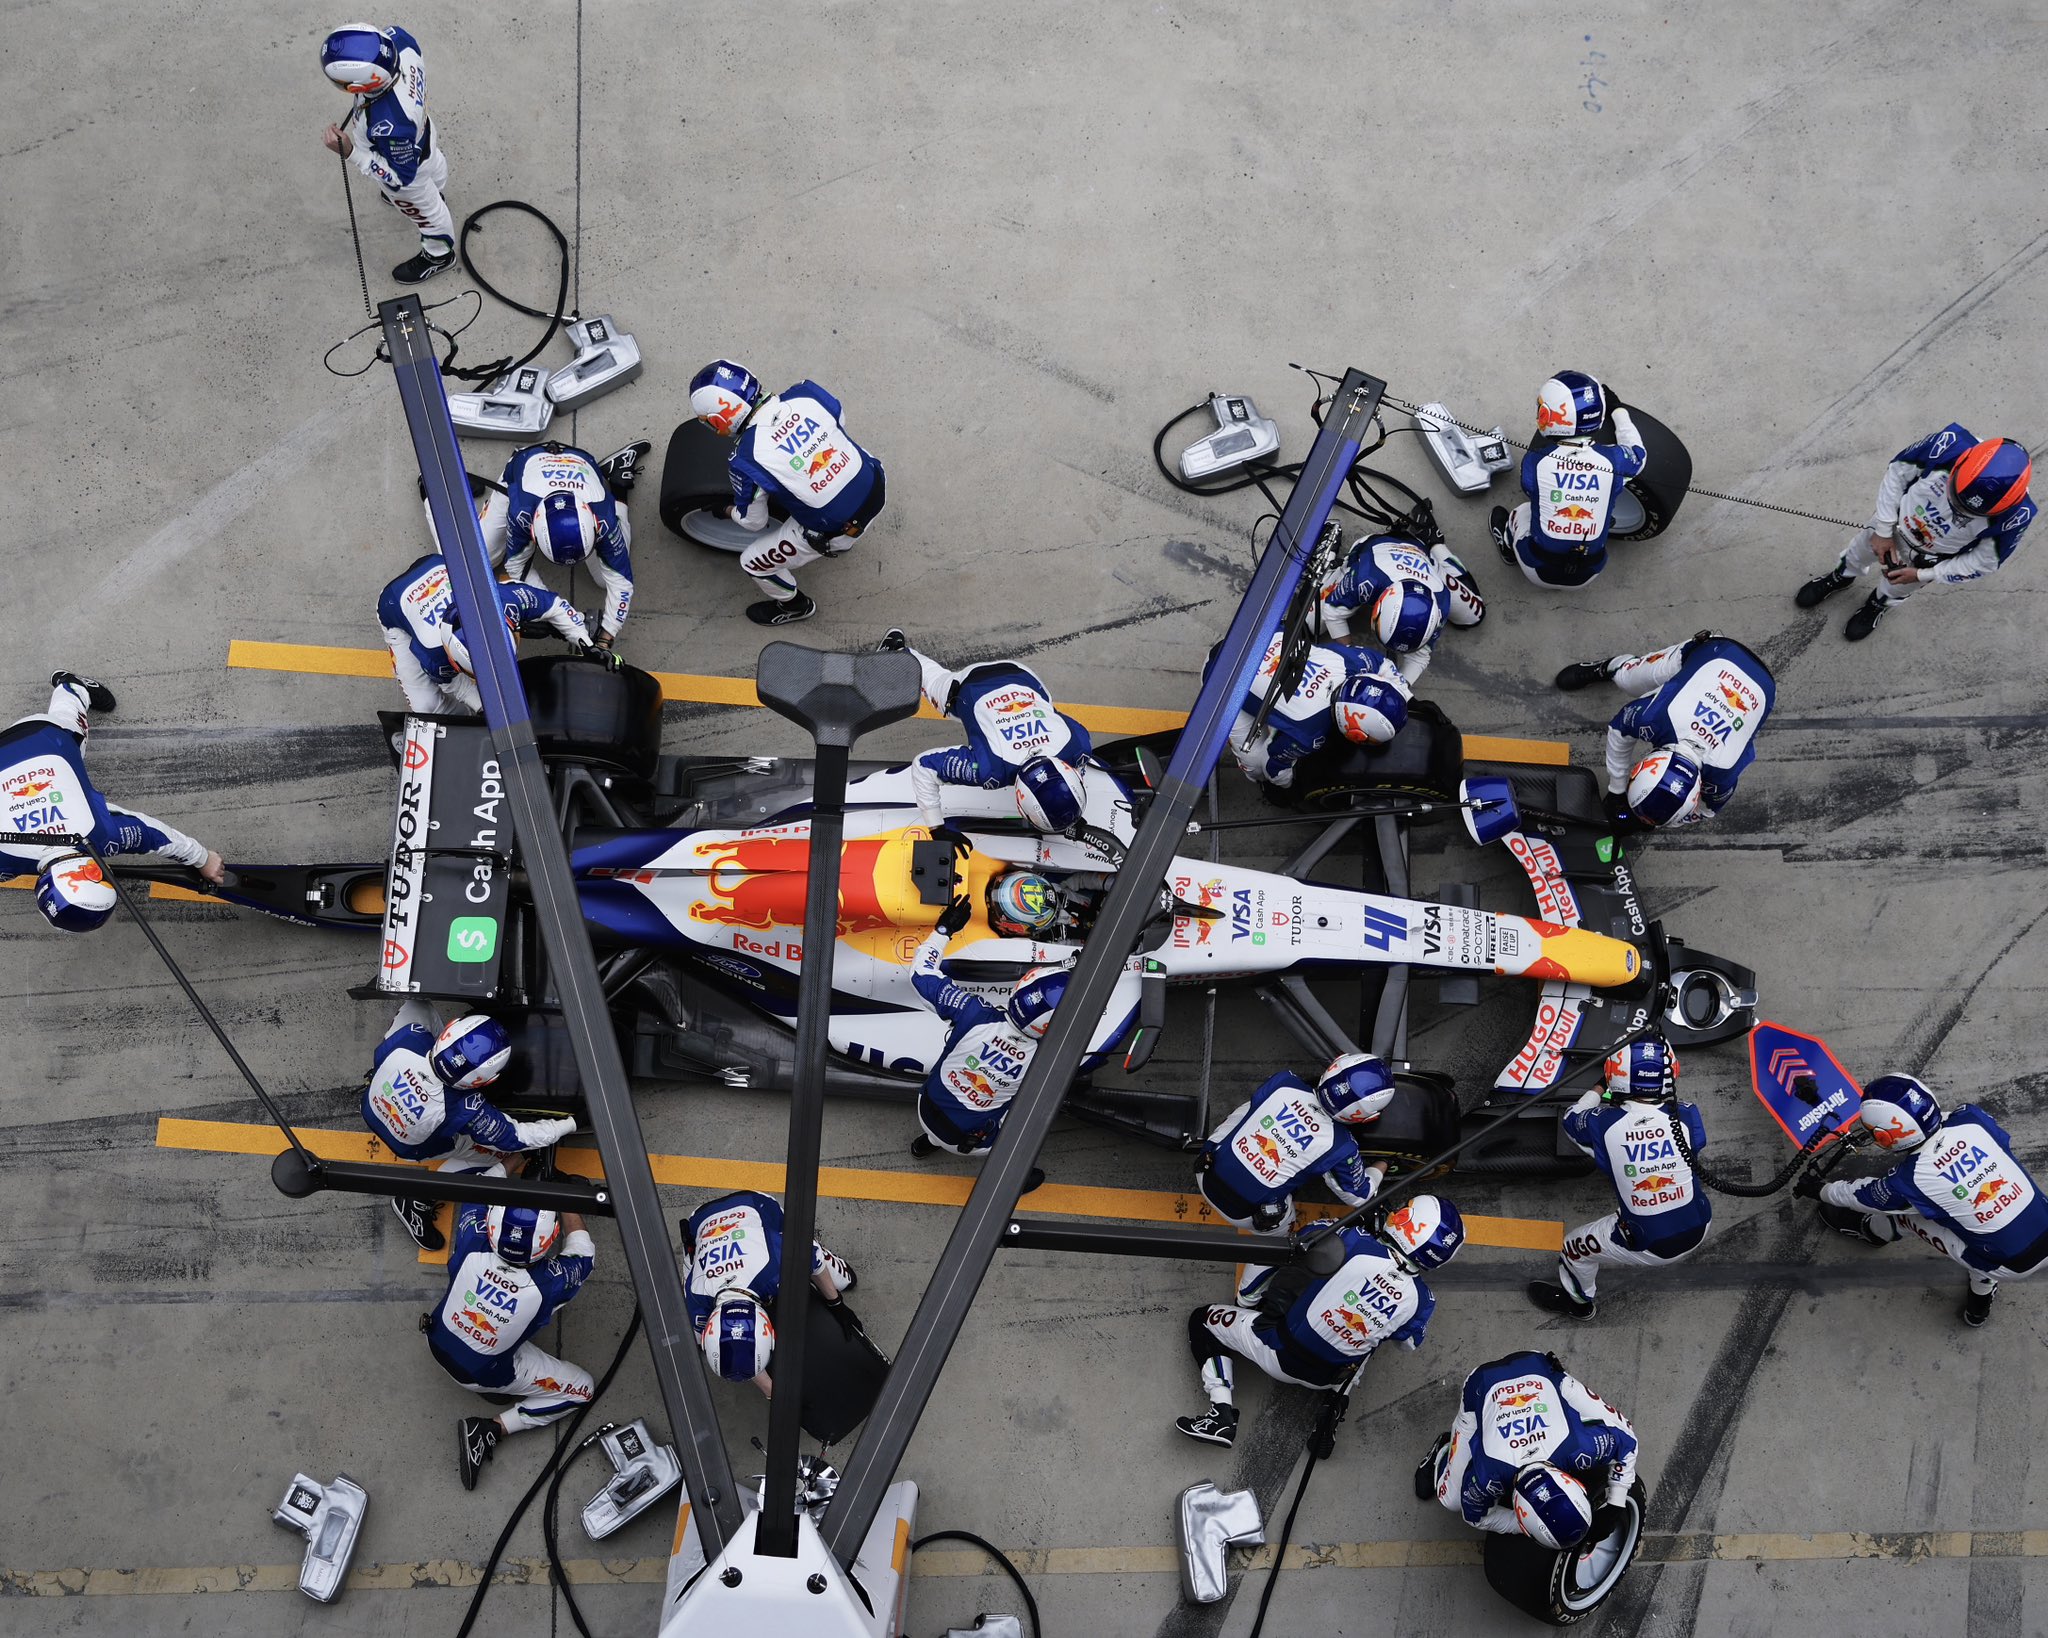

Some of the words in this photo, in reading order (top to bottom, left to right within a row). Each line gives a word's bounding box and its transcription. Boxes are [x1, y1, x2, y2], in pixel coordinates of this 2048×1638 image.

[408, 65, 416, 99] HUGO
[771, 413, 801, 443] HUGO
[775, 416, 821, 456] VISA
[802, 442, 819, 459] Cash
[815, 430, 829, 446] App
[541, 469, 588, 484] VISA
[810, 471, 833, 494] Red
[831, 450, 850, 475] Bull
[1556, 461, 1594, 471] HUGO
[549, 480, 584, 490] HUGO
[1550, 472, 1600, 491] VISA
[1565, 494, 1584, 502] Cash
[1585, 494, 1600, 503] App
[1547, 520, 1572, 534] Red
[1573, 521, 1596, 535] Bull
[1925, 499, 1951, 535] VISA
[745, 539, 798, 572] HUGO
[1390, 552, 1431, 574] VISA
[1396, 563, 1429, 581] HUGO
[406, 582, 427, 604] Bull
[429, 588, 445, 604] Cash
[419, 601, 430, 616] App
[559, 600, 584, 627] Mobil
[616, 591, 630, 623] Mobil
[1305, 667, 1331, 699] HUGO
[1718, 669, 1742, 689] Bull
[985, 694, 1010, 709] Bull
[1704, 692, 1720, 704] App
[1719, 701, 1734, 718] Cash
[1740, 686, 1759, 711] Red
[1012, 711, 1031, 721] Cash
[1693, 700, 1733, 746] VISA
[1000, 719, 1053, 741] VISA
[1012, 734, 1050, 750] HUGO
[1690, 721, 1719, 750] HUGO
[1, 774, 27, 792] Bull
[29, 767, 56, 780] Red
[25, 796, 47, 809] Cash
[474, 760, 505, 824] App
[8, 803, 26, 813] App
[12, 805, 69, 832] VISA
[1083, 832, 1110, 851] HUGO
[1509, 837, 1557, 915] HUGO
[1614, 865, 1633, 896] App
[1257, 889, 1266, 907] App
[1231, 889, 1251, 944] VISA
[1256, 908, 1264, 929] Cash
[1291, 895, 1303, 946] TUDOR
[1364, 904, 1407, 953] 41
[1623, 897, 1646, 936] Cash
[733, 932, 780, 958] Red
[1173, 915, 1191, 948] Bull
[1423, 905, 1441, 960] VISA
[1461, 909, 1471, 954] dynatrace
[1474, 910, 1482, 955] OCTAVE
[1486, 915, 1496, 964] PIRELLI
[1510, 933, 1516, 944] UP
[1551, 1009, 1577, 1048] Bull
[991, 1036, 1026, 1061] HUGO
[1507, 1003, 1557, 1083] HUGO
[981, 1041, 1024, 1080] VISA
[403, 1068, 429, 1103] HUGO
[948, 1070, 968, 1093] Red
[967, 1090, 993, 1109] Bull
[978, 1066, 996, 1082] Cash
[994, 1075, 1010, 1088] App
[391, 1069, 426, 1121] VISA
[372, 1096, 390, 1123] Red
[388, 1117, 409, 1140] Bull
[390, 1095, 405, 1115] Cash
[402, 1112, 417, 1127] App
[1291, 1099, 1320, 1133] HUGO
[1798, 1088, 1849, 1132] Airtasker
[1274, 1102, 1314, 1151] VISA
[1625, 1128, 1665, 1142] HUGO
[1270, 1127, 1286, 1145] Cash
[1283, 1143, 1298, 1159] App
[1620, 1139, 1675, 1163] VISA
[1933, 1140, 1967, 1170] HUGO
[1235, 1136, 1258, 1165] Red
[1253, 1157, 1278, 1182] Bull
[1639, 1164, 1660, 1174] Cash
[1660, 1161, 1677, 1173] App
[1937, 1145, 1988, 1185] VISA
[1967, 1172, 1985, 1189] Cash
[1984, 1161, 1998, 1176] App
[1631, 1194, 1658, 1207] Red
[1658, 1187, 1684, 1203] Bull
[1975, 1203, 2003, 1224] Red
[1998, 1183, 2023, 1208] Bull
[710, 1235, 729, 1247] Cash
[699, 1241, 748, 1271] VISA
[706, 1258, 744, 1279] HUGO
[475, 1273, 520, 1315] VISA
[483, 1268, 519, 1294] HUGO
[1373, 1273, 1403, 1301] HUGO
[1358, 1276, 1399, 1320] VISA
[476, 1301, 494, 1317] Cash
[493, 1311, 510, 1325] App
[1355, 1303, 1372, 1319] Cash
[1370, 1315, 1384, 1329] App
[451, 1311, 474, 1335] Red
[472, 1329, 498, 1349] Bull
[1320, 1309, 1344, 1337] Red
[1340, 1328, 1366, 1349] Bull
[564, 1383, 582, 1396] Red
[1492, 1384, 1516, 1402] Bull
[1516, 1380, 1544, 1393] Red
[1495, 1410, 1511, 1422] App
[1511, 1406, 1532, 1418] Cash
[1497, 1414, 1550, 1439] VISA
[1510, 1431, 1546, 1449] HUGO
